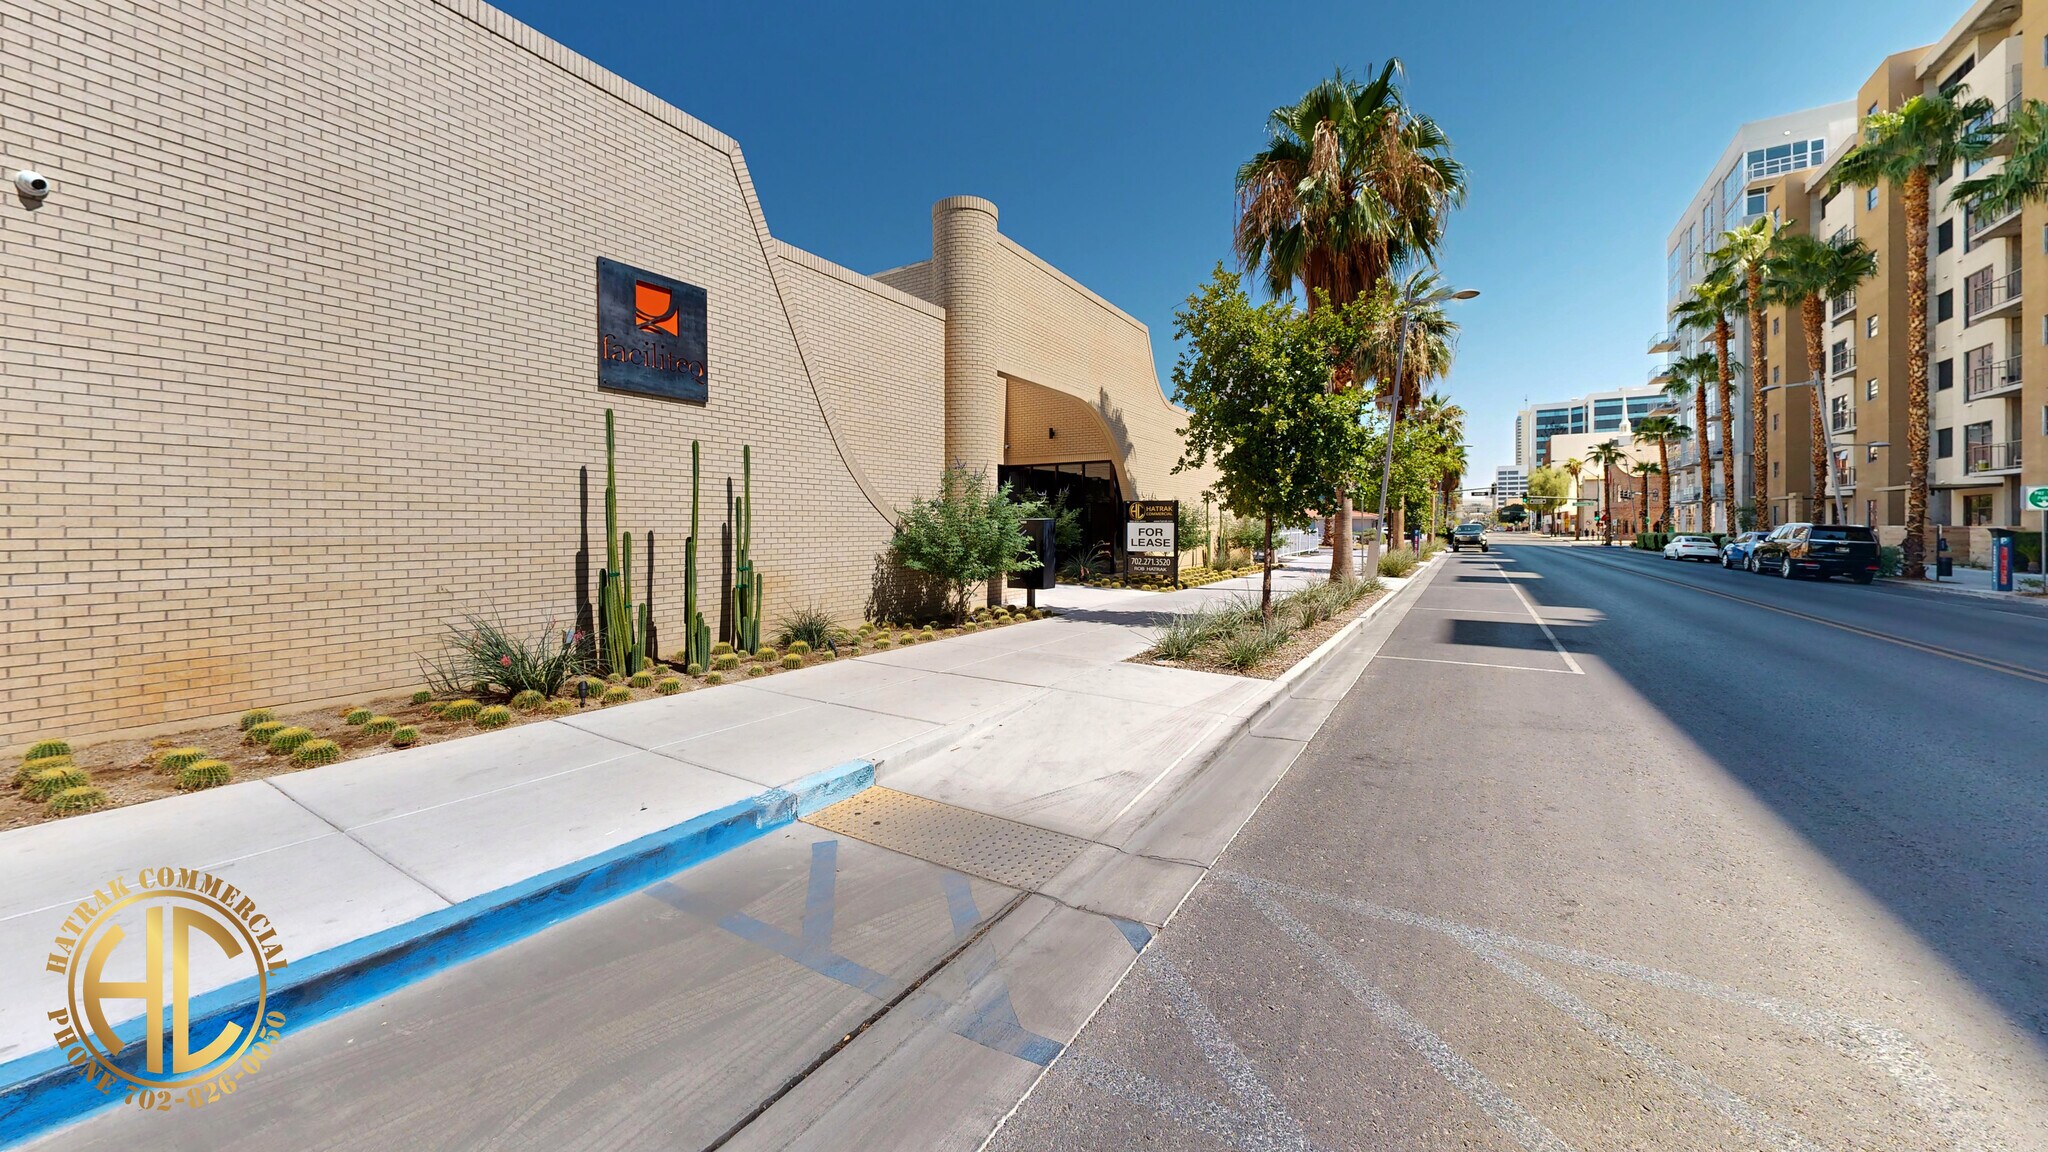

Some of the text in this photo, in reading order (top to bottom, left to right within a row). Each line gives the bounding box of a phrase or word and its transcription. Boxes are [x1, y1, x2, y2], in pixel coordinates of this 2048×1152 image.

[1138, 527, 1163, 537] FOR
[1131, 538, 1171, 547] LEASE
[1131, 557, 1171, 566] 702.271.3520
